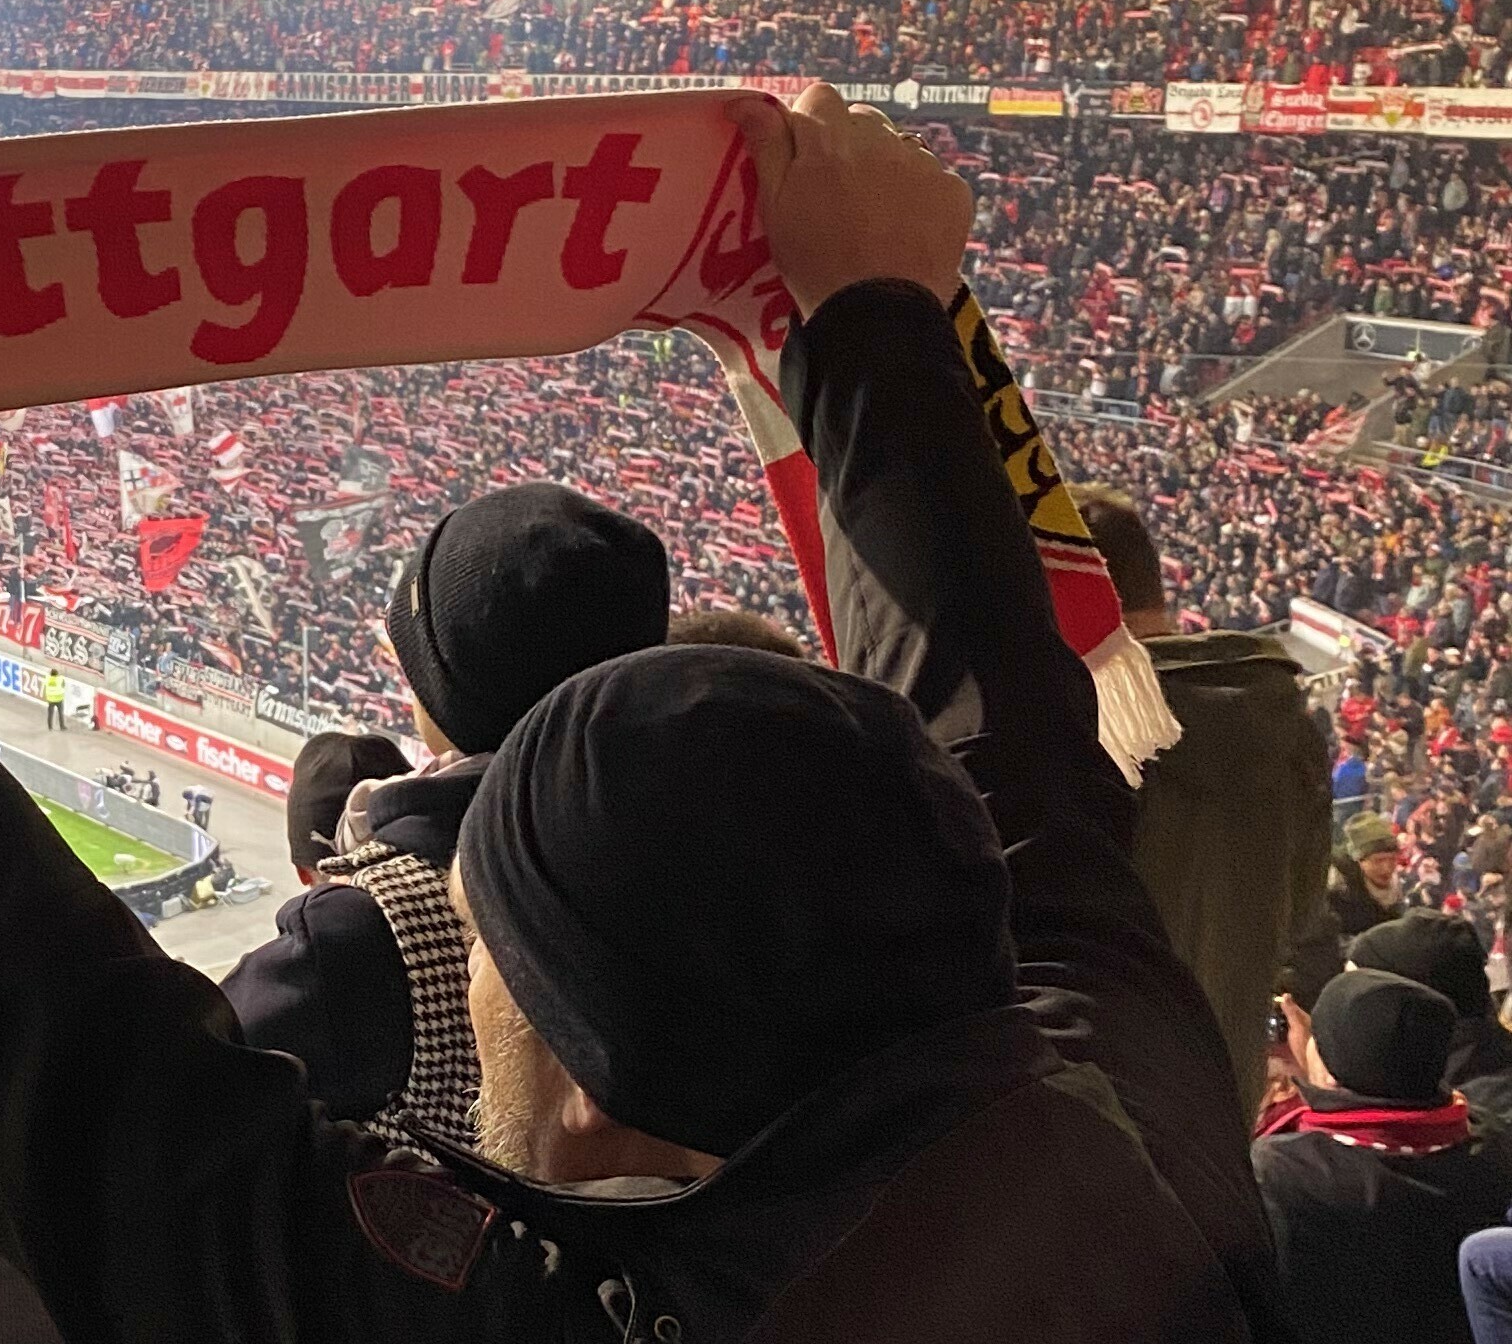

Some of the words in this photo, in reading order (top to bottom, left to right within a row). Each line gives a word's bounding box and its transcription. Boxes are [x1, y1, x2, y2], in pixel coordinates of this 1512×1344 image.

[421, 75, 488, 101] KURVE
[921, 85, 990, 103] STUTTGART
[22, 670, 46, 698] 247
[104, 701, 162, 745] fischer
[196, 736, 261, 784] fischer
